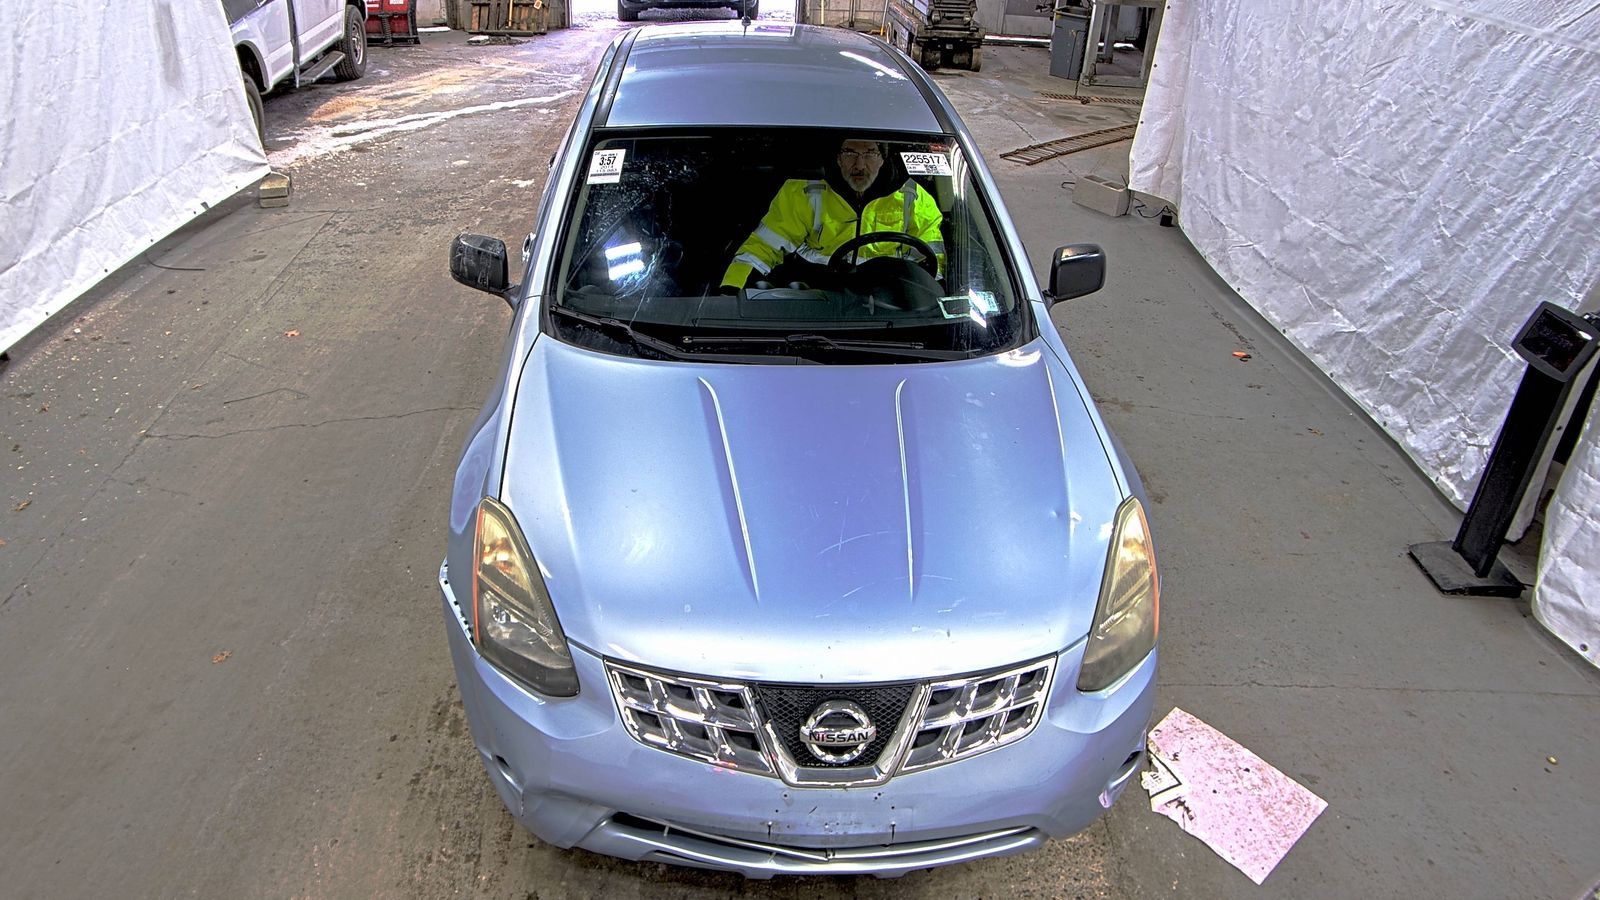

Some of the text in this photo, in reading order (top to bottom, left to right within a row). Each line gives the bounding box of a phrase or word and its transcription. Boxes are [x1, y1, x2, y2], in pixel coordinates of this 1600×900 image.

[599, 156, 617, 166] 3:57
[904, 154, 940, 164] 225517
[809, 730, 868, 742] NISSAN
